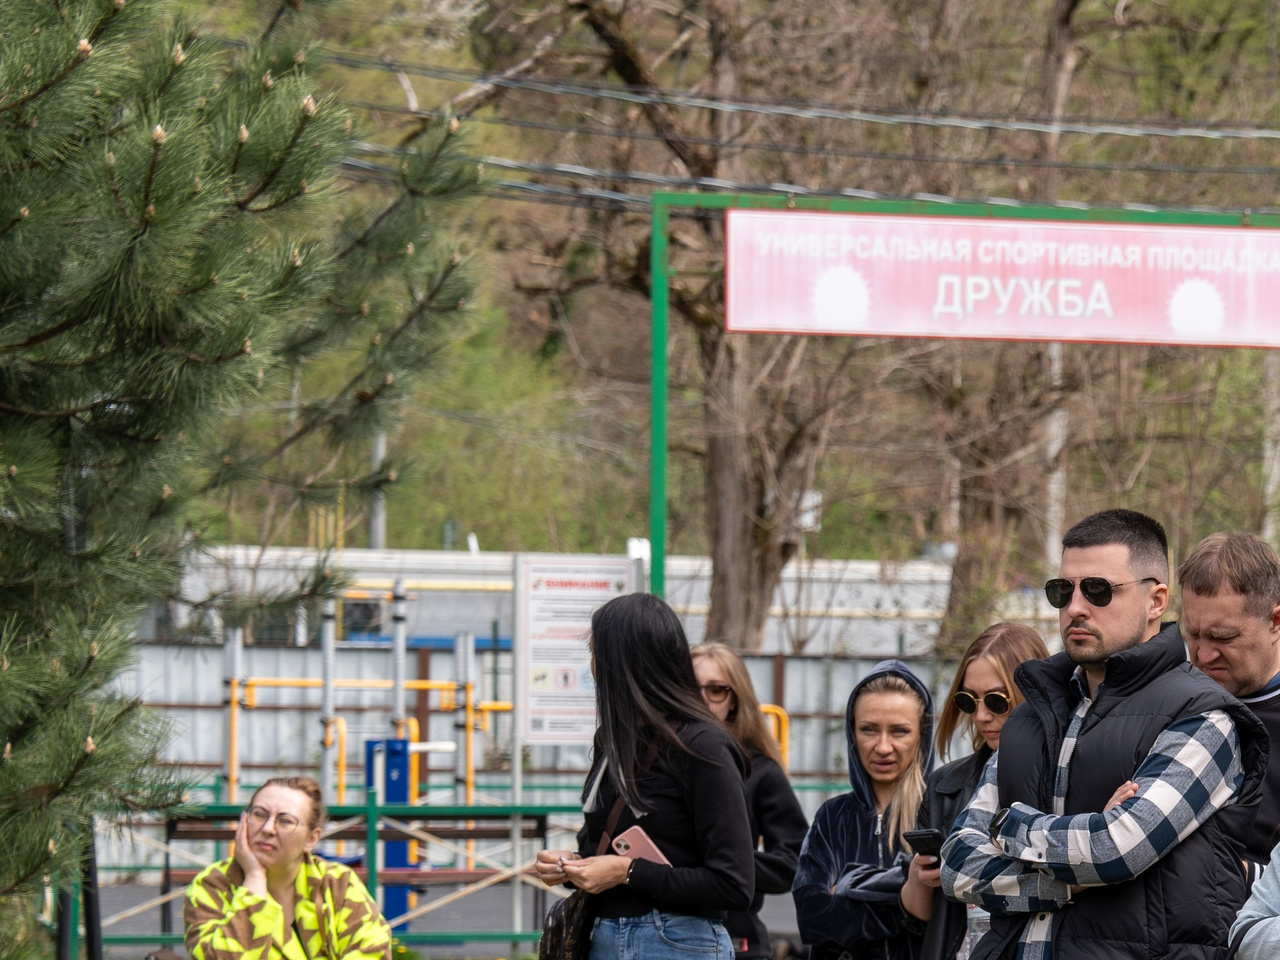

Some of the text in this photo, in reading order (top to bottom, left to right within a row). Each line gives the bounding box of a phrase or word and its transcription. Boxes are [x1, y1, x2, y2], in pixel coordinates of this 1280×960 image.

[756, 232, 972, 263] УНИВЕРСАЛЬНАЯ
[978, 239, 1141, 269] СПОРТИВНАЯ
[932, 274, 1115, 321] ДРУЖБА
